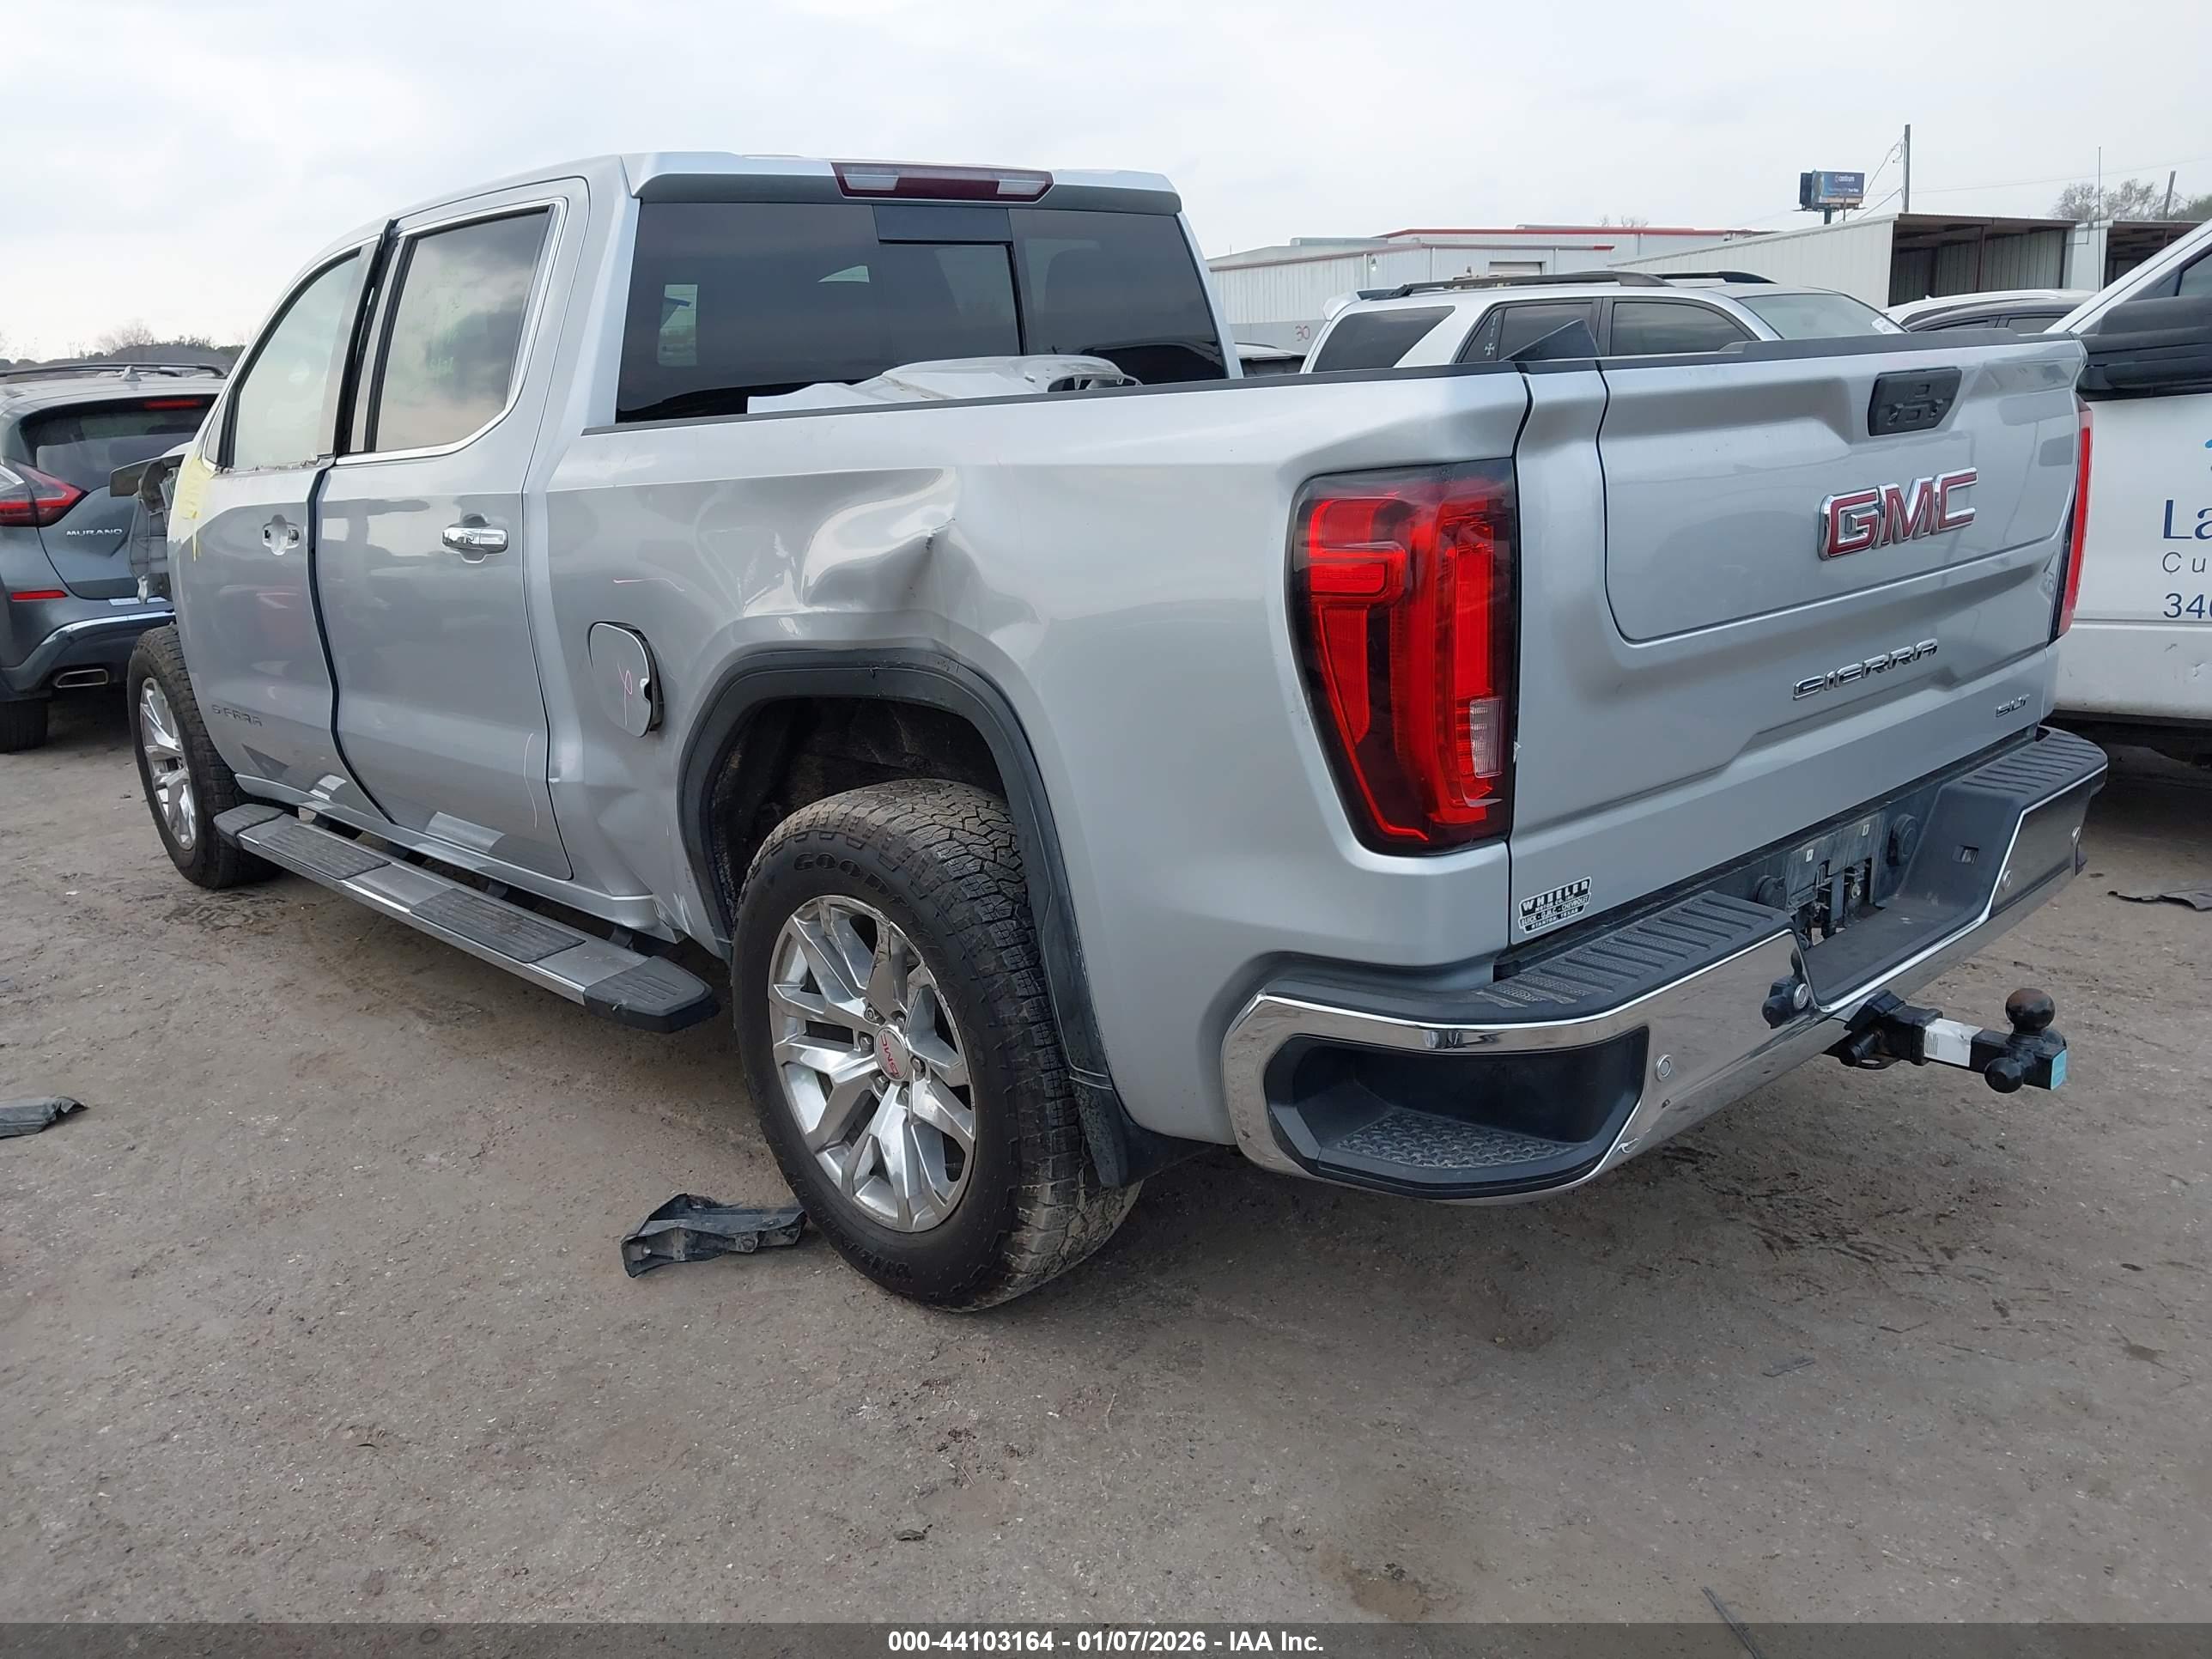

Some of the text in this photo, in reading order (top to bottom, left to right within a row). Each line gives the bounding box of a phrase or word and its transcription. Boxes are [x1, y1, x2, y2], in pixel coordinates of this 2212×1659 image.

[1819, 467, 1978, 561] GMC
[66, 528, 123, 537] MURANO
[2163, 592, 2212, 619] 34
[1793, 638, 1938, 701] SIERRA
[211, 704, 263, 727] SERRA
[1996, 694, 2030, 718] SLT
[1522, 880, 1589, 911] WHEELER
[1521, 915, 1537, 927] BUICK
[1561, 896, 1589, 910] CHEVROLET
[1560, 908, 1579, 918] TEXAS
